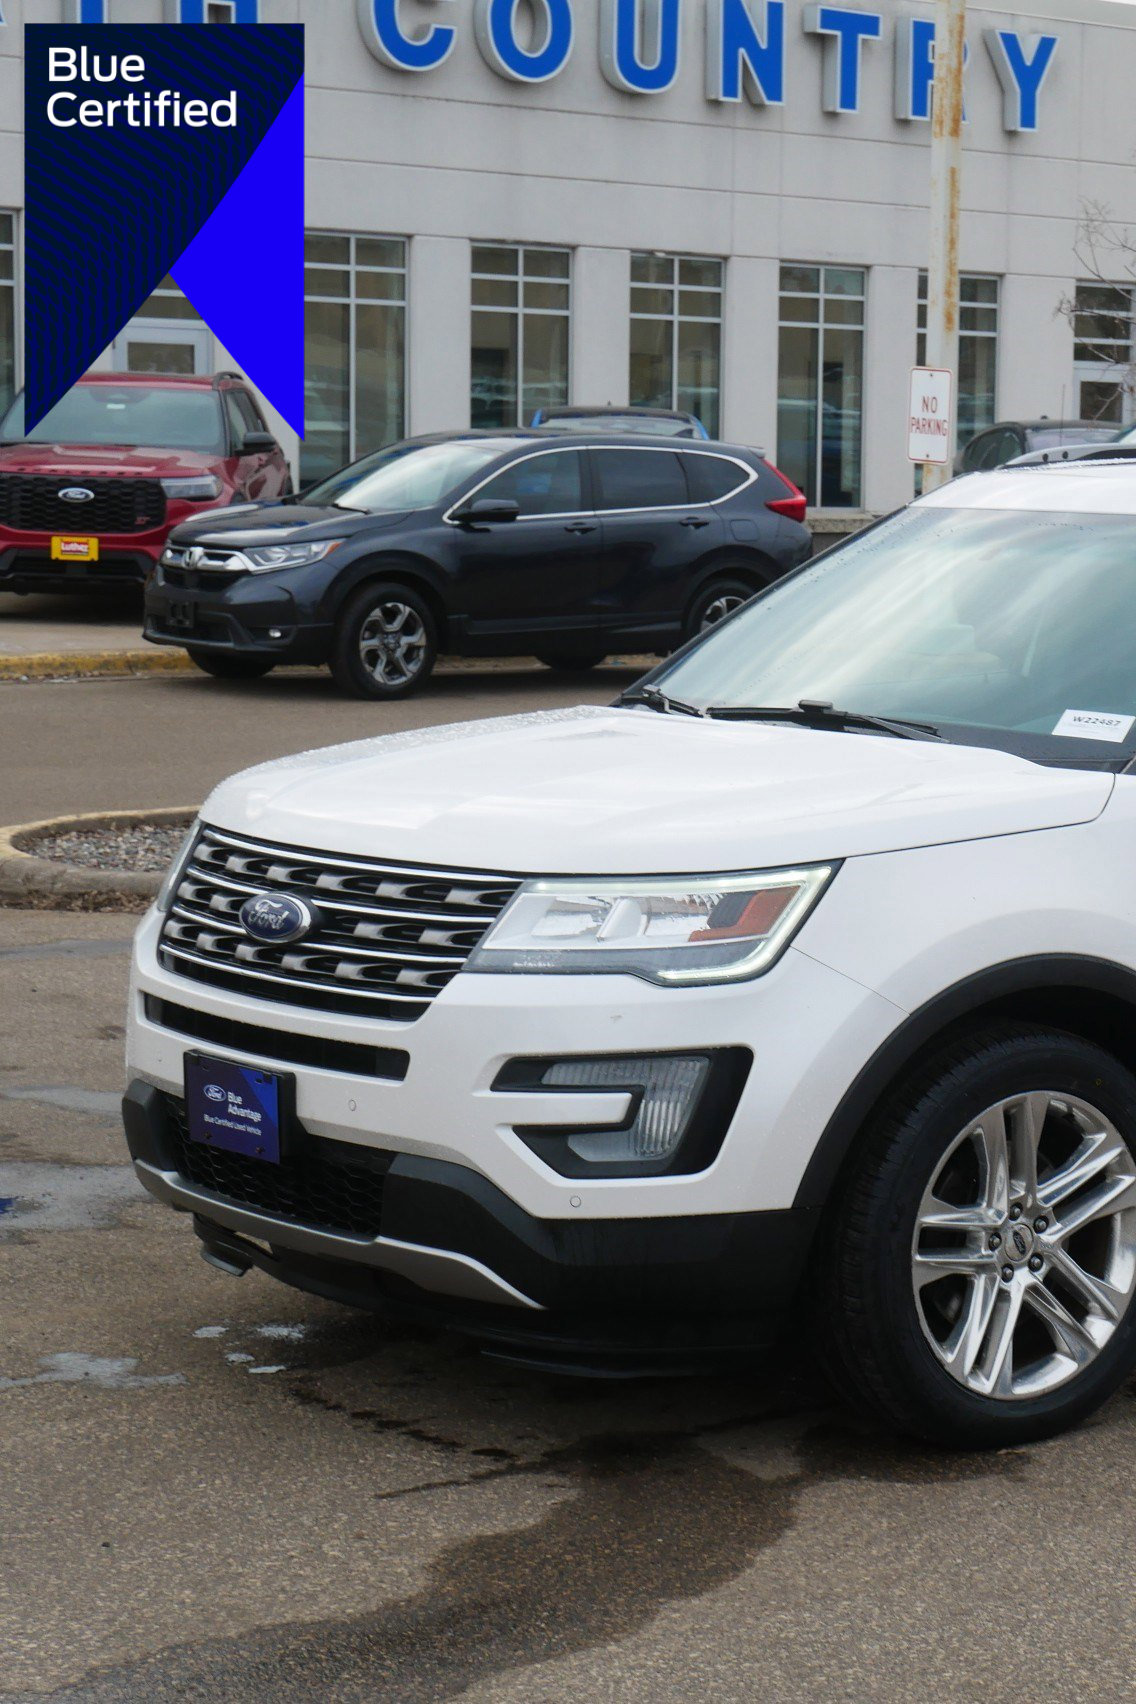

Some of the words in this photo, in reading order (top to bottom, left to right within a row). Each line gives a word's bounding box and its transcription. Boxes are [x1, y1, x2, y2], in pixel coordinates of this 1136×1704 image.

[922, 396, 938, 413] NO
[910, 416, 949, 436] PARKING
[1073, 715, 1122, 727] W22487
[248, 900, 290, 930] Ford
[228, 1091, 242, 1104] Blue
